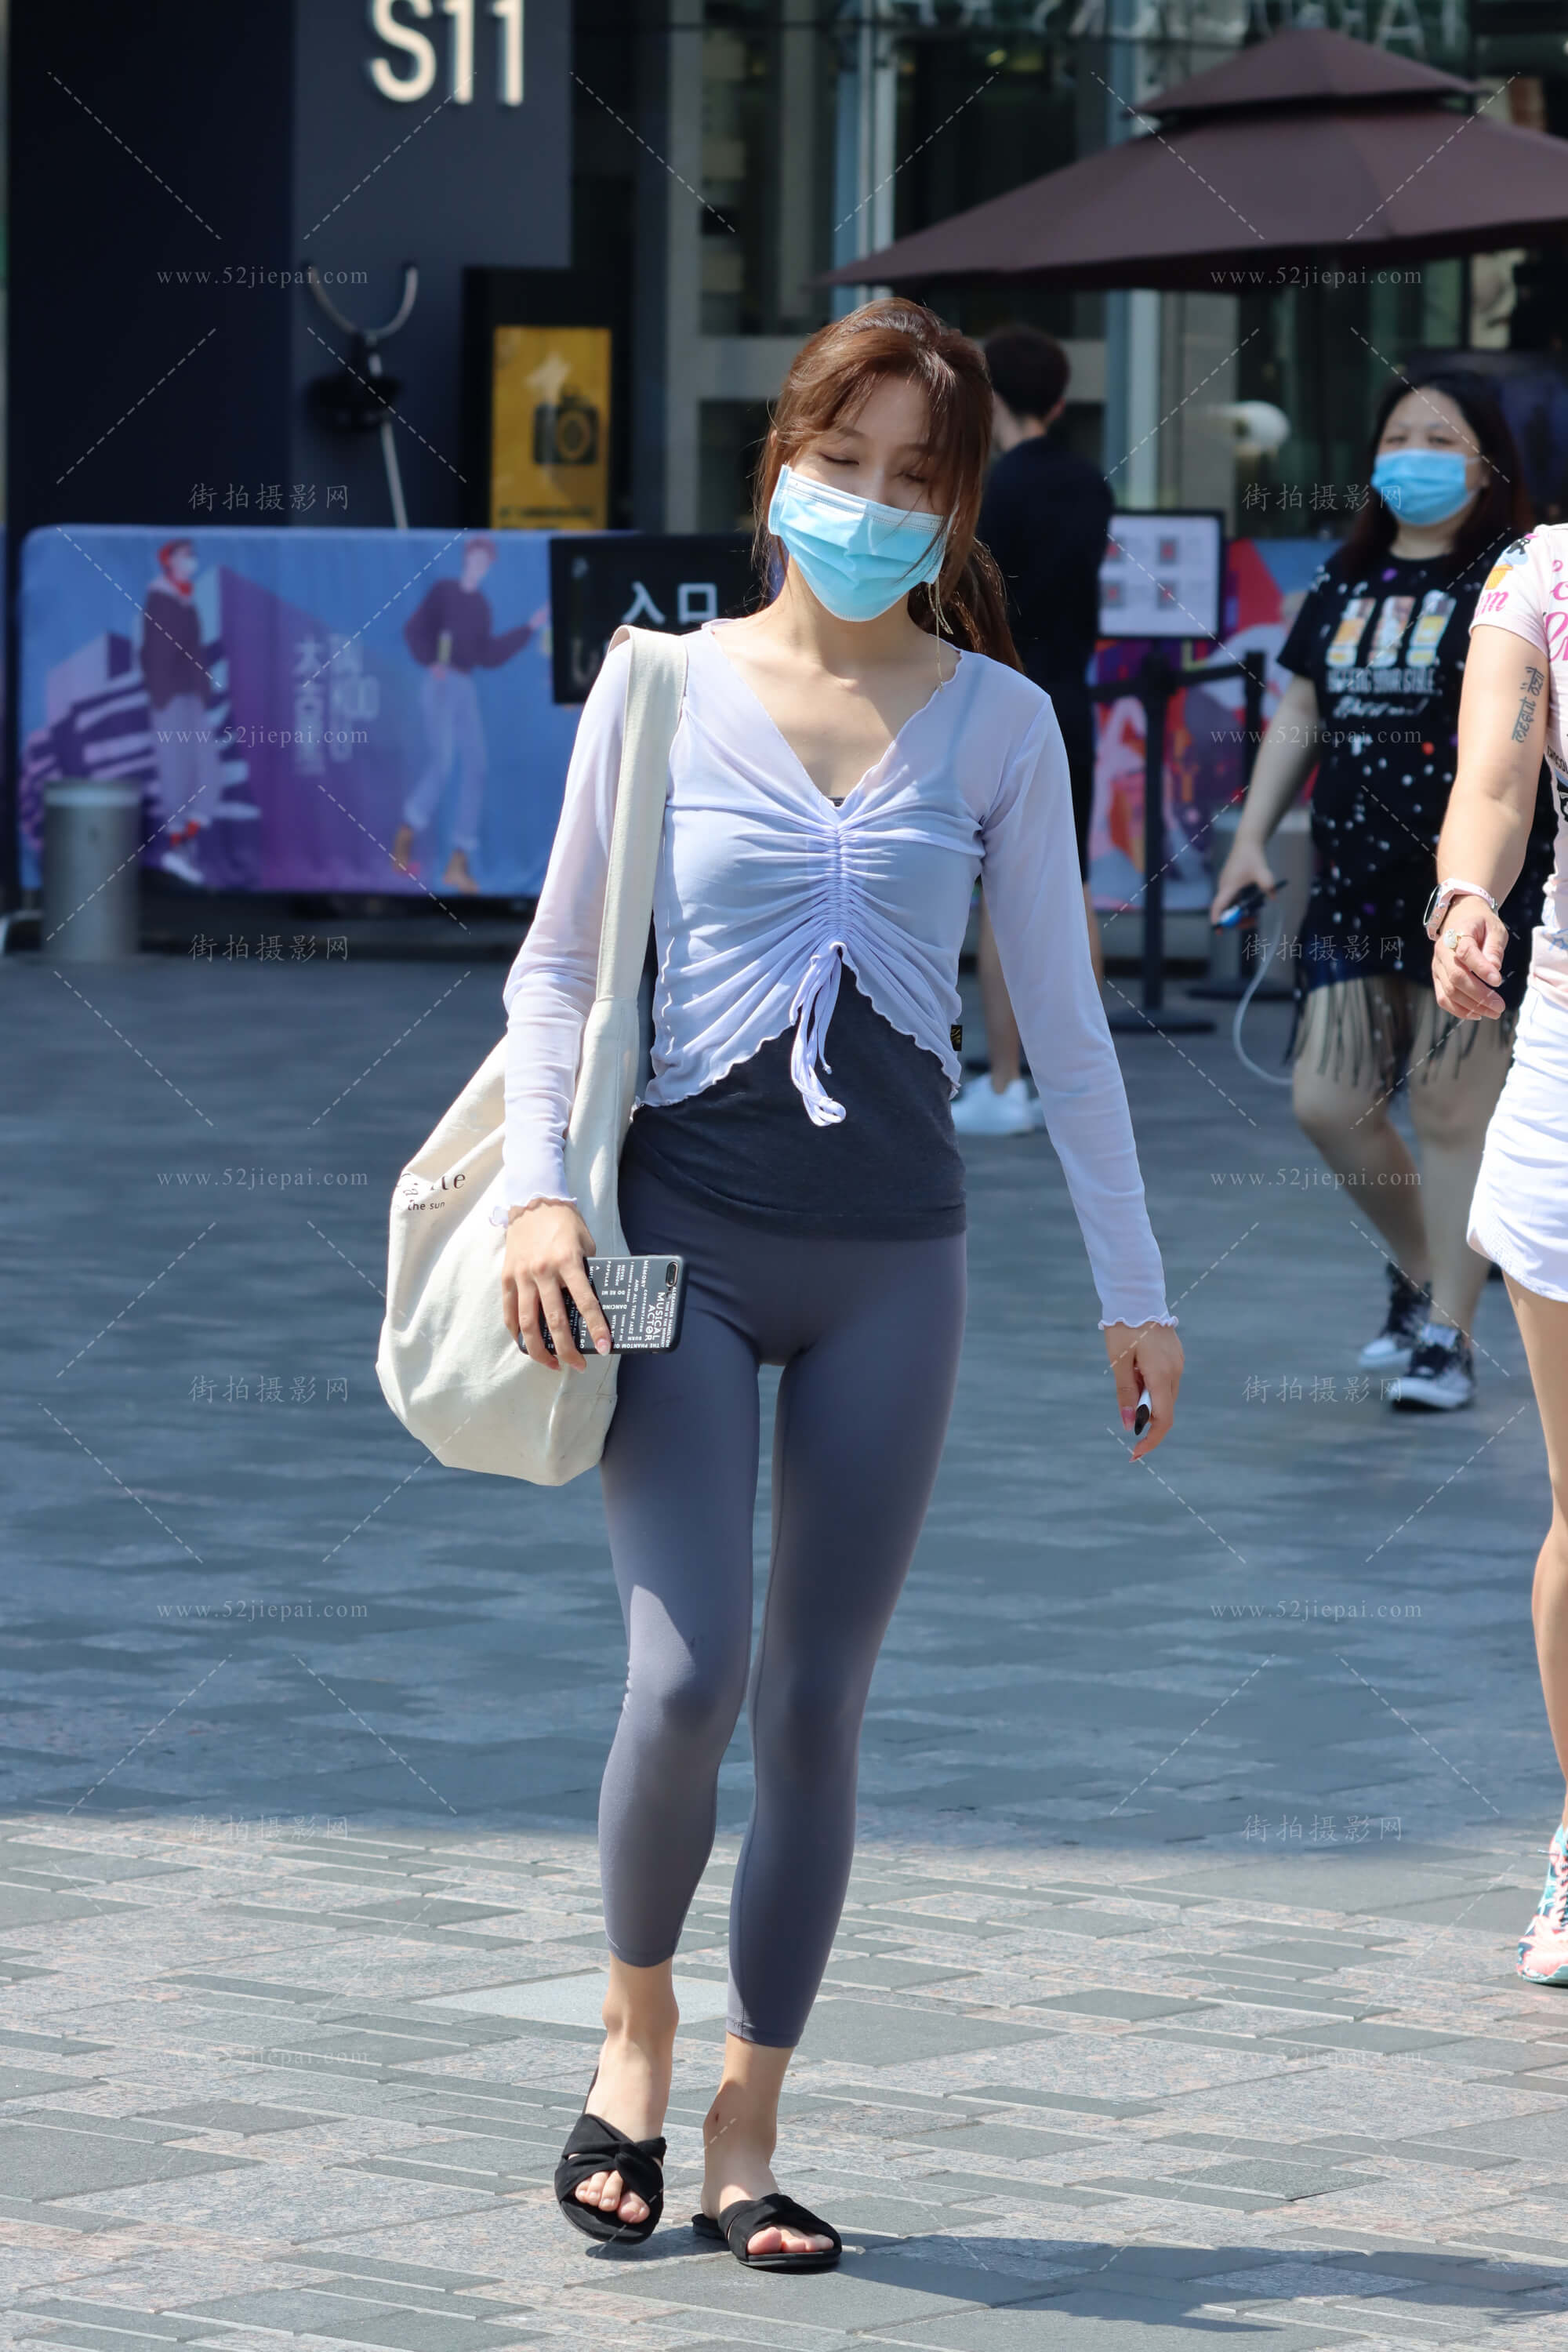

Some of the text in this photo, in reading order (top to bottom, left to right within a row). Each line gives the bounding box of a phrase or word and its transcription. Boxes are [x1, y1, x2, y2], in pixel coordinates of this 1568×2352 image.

[372, 0, 524, 105] S11
[622, 581, 718, 625] 入口
[429, 1201, 445, 1210] sun
[644, 1305, 656, 1341] ACTOR
[652, 1292, 666, 1341] MUSICAL
[579, 1339, 585, 1348] GO
